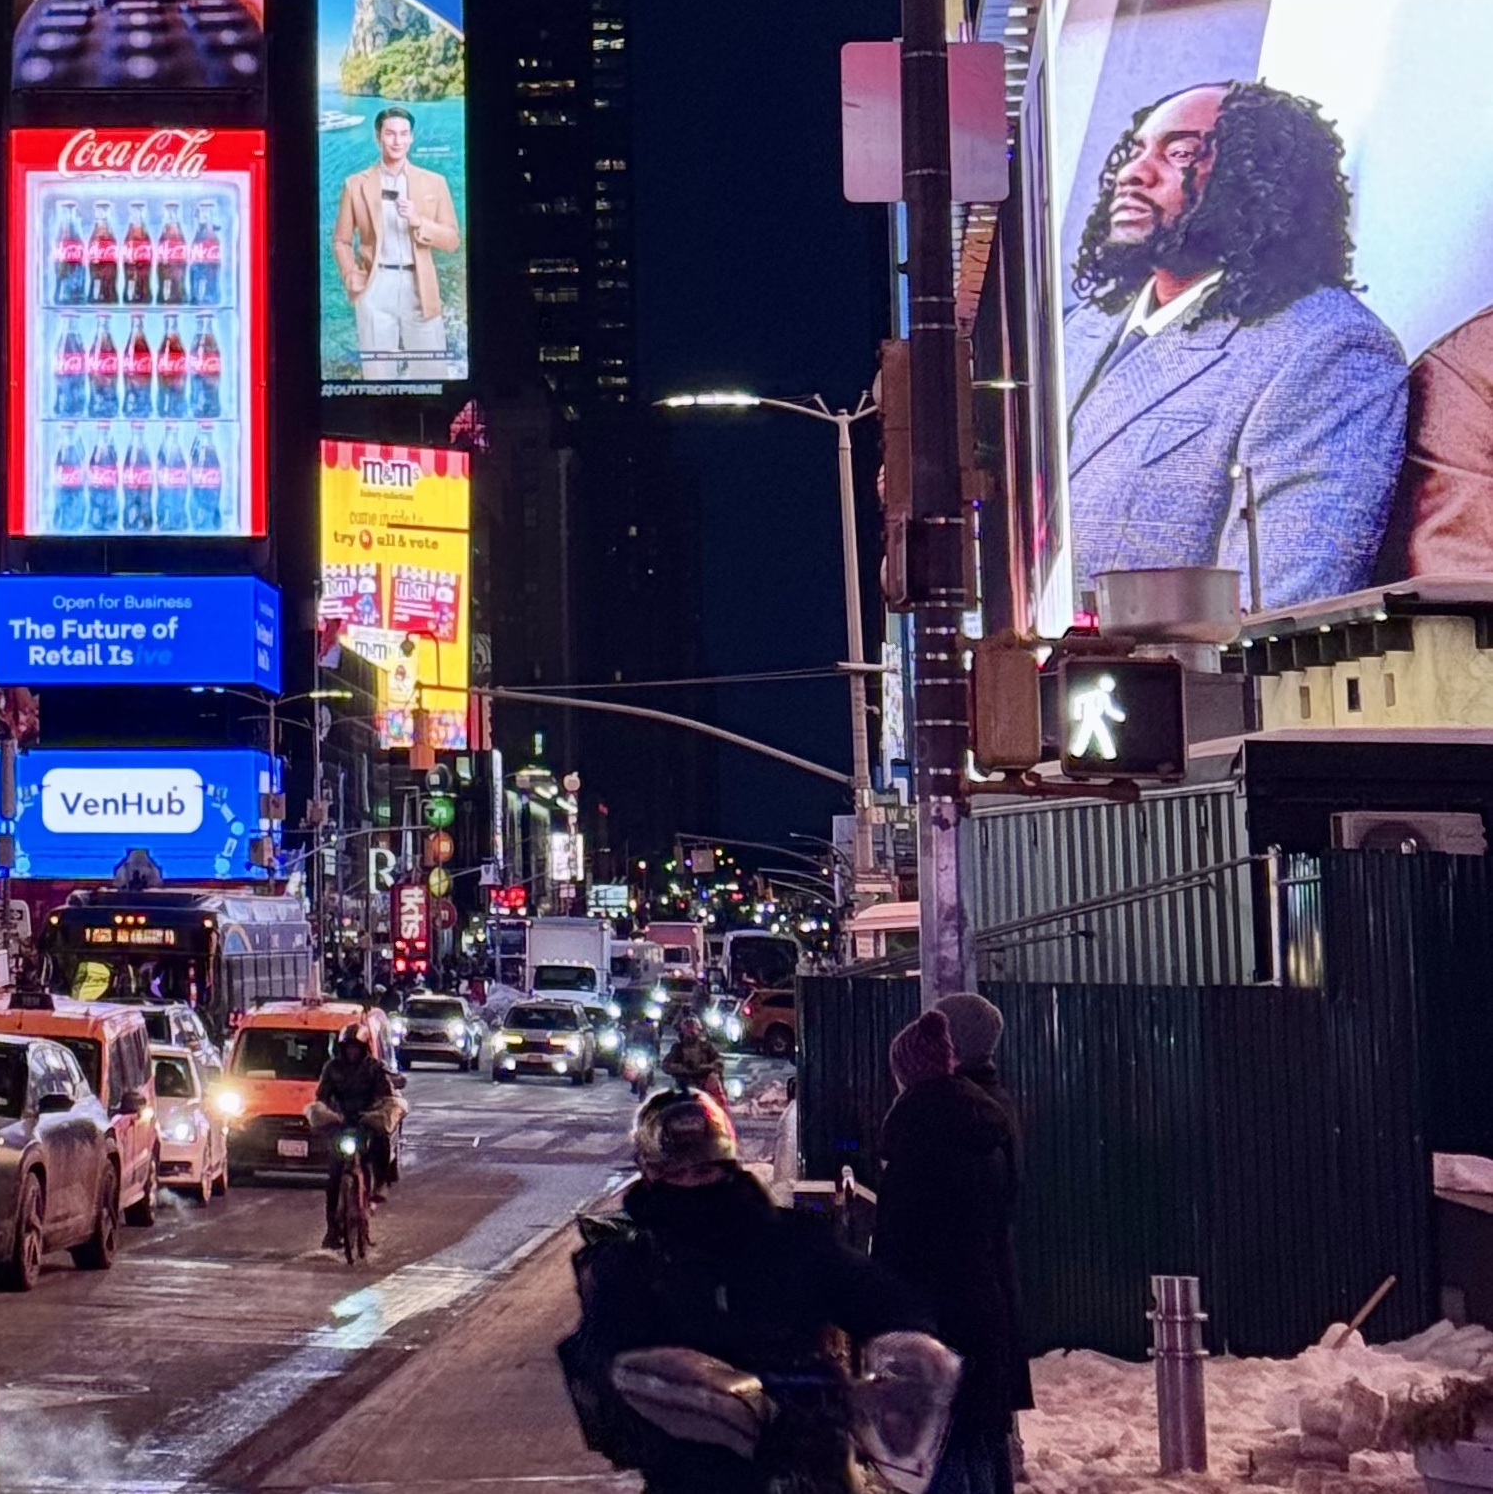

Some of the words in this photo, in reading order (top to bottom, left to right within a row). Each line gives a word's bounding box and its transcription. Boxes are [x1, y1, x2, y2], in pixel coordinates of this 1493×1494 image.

[58, 127, 214, 180] Coca-Cola
[333, 530, 355, 547] try
[377, 533, 396, 547] all
[409, 537, 439, 550] vote
[53, 594, 95, 613] Open
[98, 593, 119, 609] for
[124, 594, 192, 609] Business
[8, 617, 56, 639] The
[62, 618, 146, 639] Future
[152, 616, 179, 639] of
[29, 642, 103, 666] Retail
[108, 645, 134, 666] Is
[61, 790, 186, 816] VenHub
[400, 887, 427, 940] tkts
